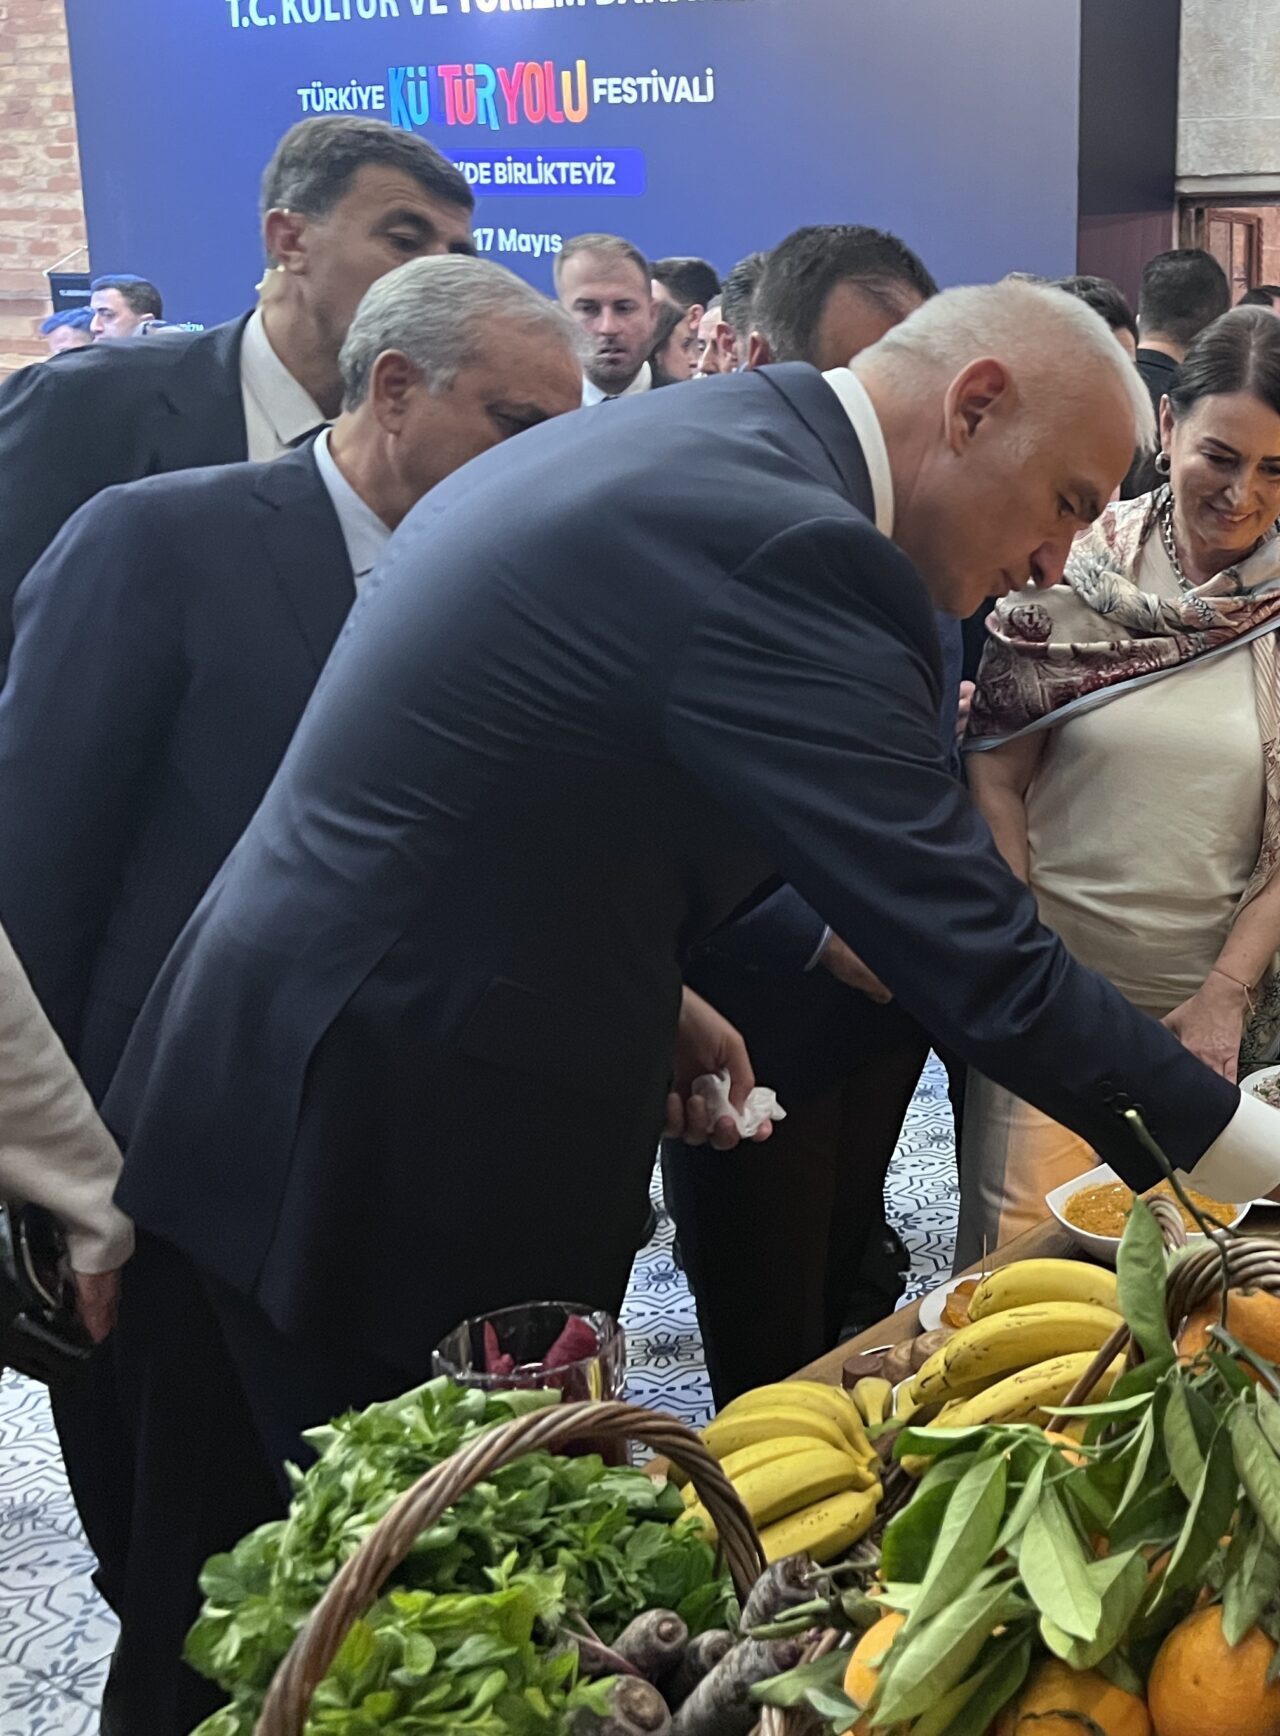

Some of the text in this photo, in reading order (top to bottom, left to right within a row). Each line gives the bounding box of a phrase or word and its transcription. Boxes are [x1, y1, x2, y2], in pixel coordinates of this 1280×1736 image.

[225, 0, 276, 28] T.C.
[297, 79, 385, 112] TÜRKİYE
[592, 67, 714, 104] FESTİVALİ
[494, 155, 616, 185] BİRLİKTEYİZ
[497, 228, 563, 257] Mayıs
